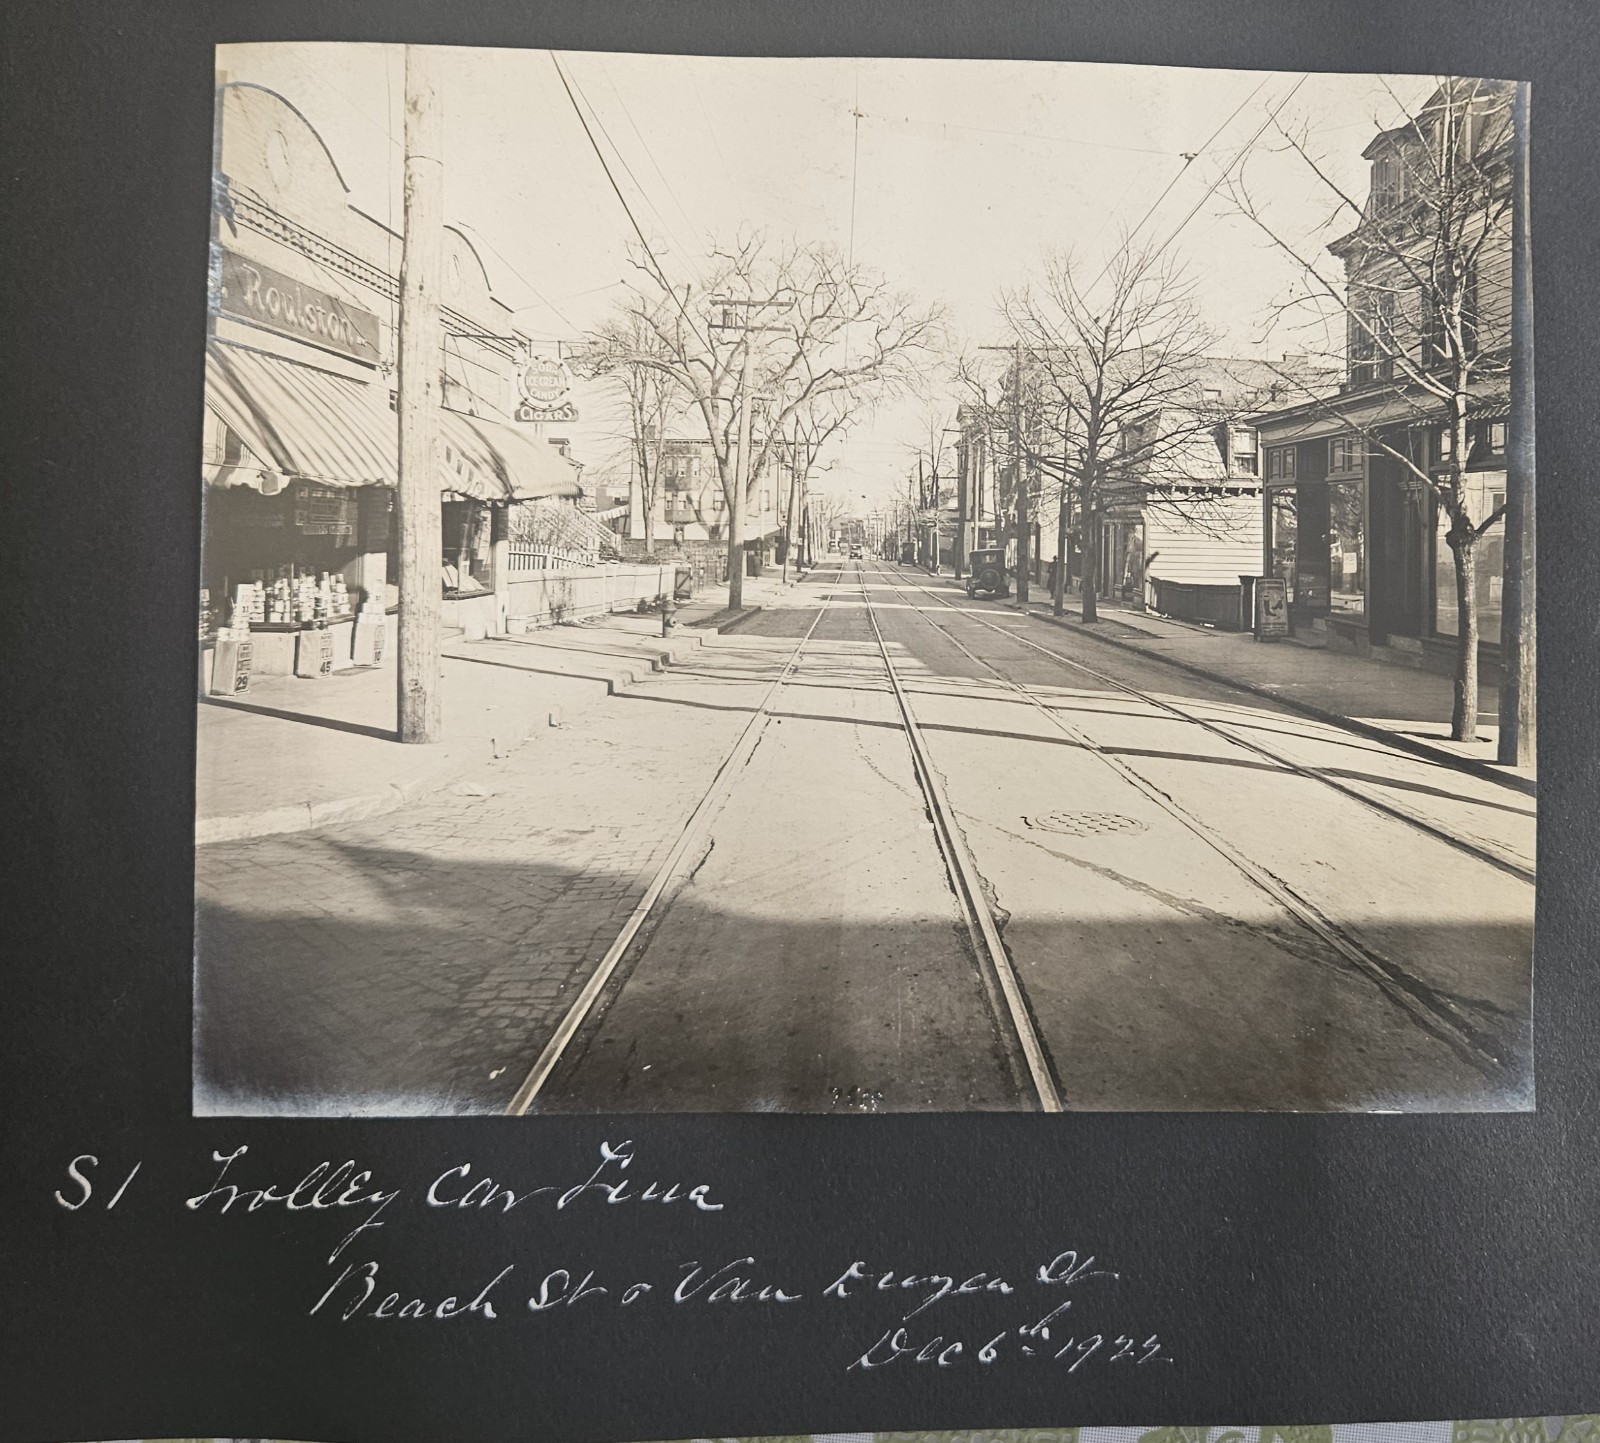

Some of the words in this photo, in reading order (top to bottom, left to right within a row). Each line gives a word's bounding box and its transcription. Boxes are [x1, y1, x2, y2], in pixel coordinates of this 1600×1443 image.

[240, 262, 354, 346] Roulston
[531, 363, 559, 376] SODA
[526, 376, 539, 388] ICE
[530, 388, 560, 400] CANDY
[520, 405, 573, 421] CIGARS
[320, 661, 332, 674] 45
[235, 675, 248, 692] 29
[185, 1144, 401, 1264] Trolley
[426, 1162, 560, 1213] Car
[556, 1140, 724, 1212] Line
[310, 1260, 514, 1321] Beach
[528, 1269, 608, 1311] St
[674, 1257, 803, 1304] Van
[1036, 1250, 1120, 1285] St
[847, 1327, 963, 1372] Dec
[1054, 1334, 1174, 1374] 1922
